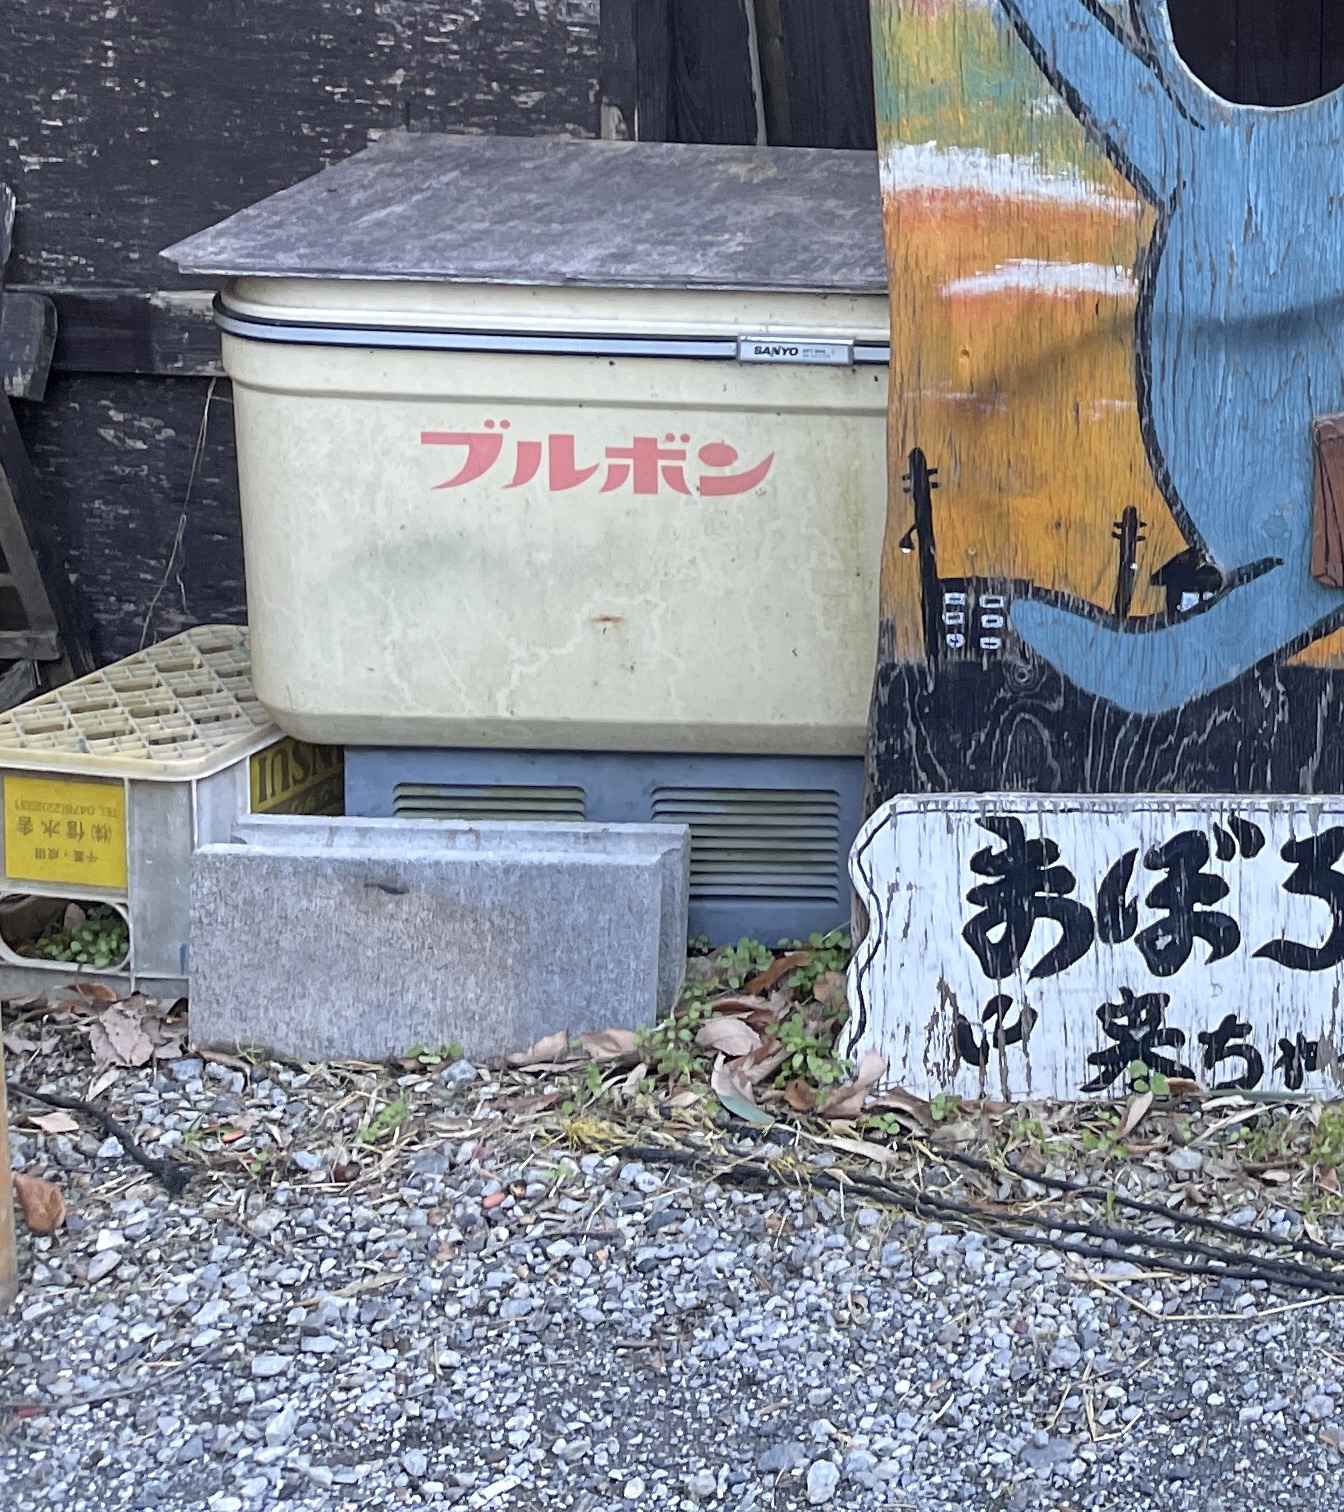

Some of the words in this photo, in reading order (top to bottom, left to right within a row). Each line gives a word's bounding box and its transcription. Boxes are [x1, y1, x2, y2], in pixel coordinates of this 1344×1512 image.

[753, 345, 800, 356] SANYO
[419, 418, 776, 498] ブルボン
